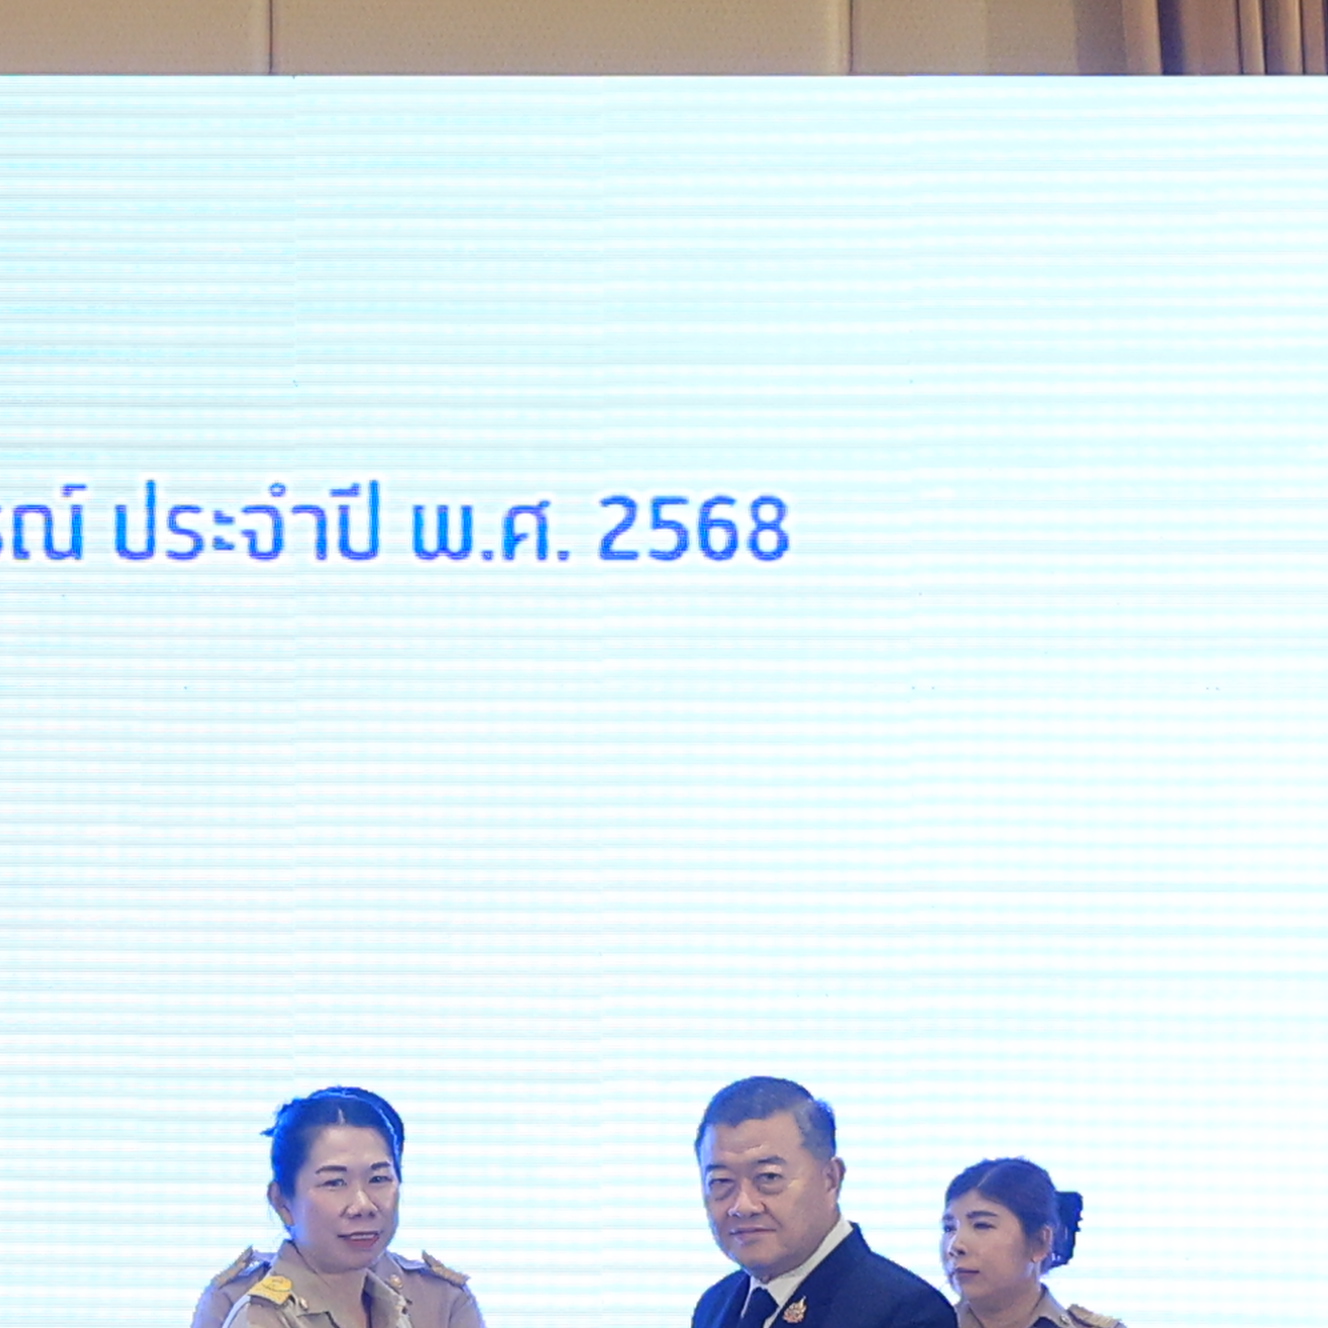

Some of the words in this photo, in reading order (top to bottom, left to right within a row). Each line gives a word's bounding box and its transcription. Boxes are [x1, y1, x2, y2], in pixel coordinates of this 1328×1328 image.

[114, 480, 381, 562] ประจำปี
[412, 497, 570, 562] พ.ศ.
[599, 494, 790, 562] 2568
